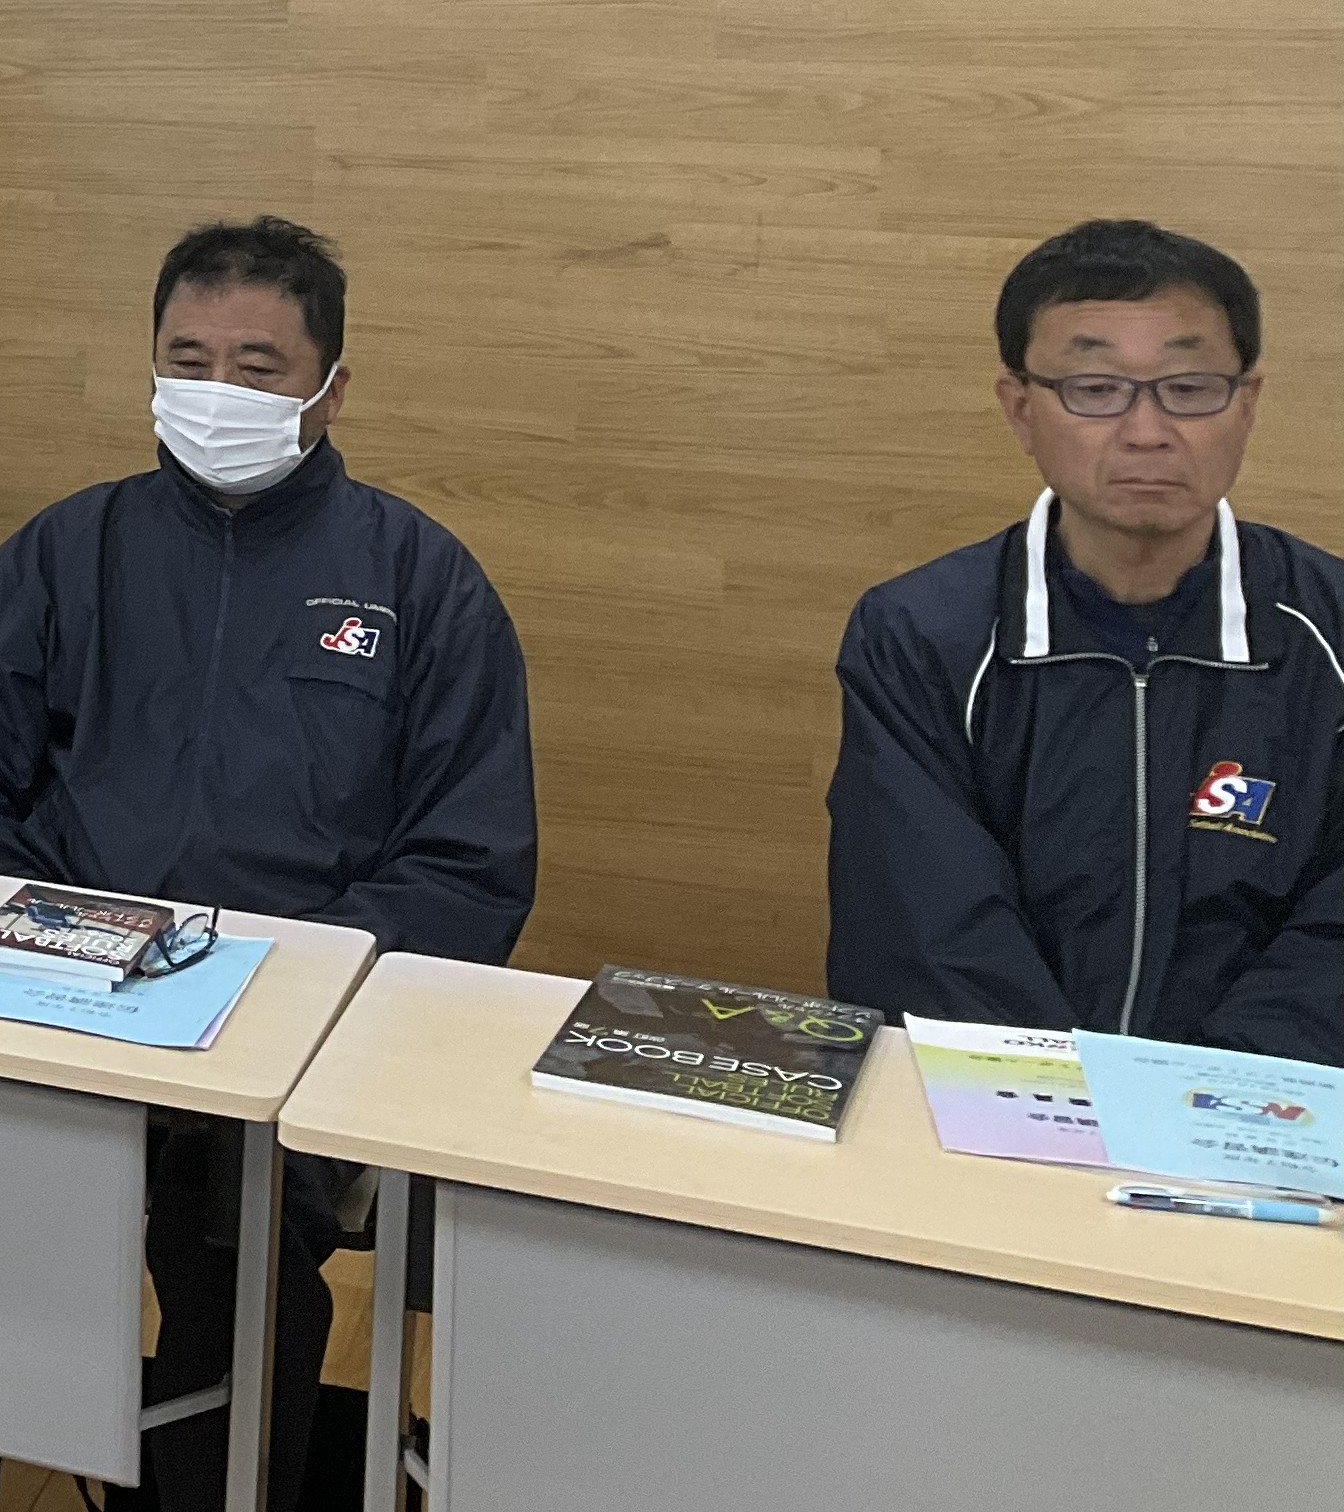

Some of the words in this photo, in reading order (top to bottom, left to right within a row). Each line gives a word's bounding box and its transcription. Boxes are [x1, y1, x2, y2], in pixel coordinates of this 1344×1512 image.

[42, 929, 134, 954] RULES
[563, 1029, 704, 1066] BOOK
[669, 1071, 835, 1111] SOFTBALL
[709, 1055, 843, 1091] CASE
[725, 1073, 840, 1102] RULES
[686, 1085, 830, 1122] OFFICIAL
